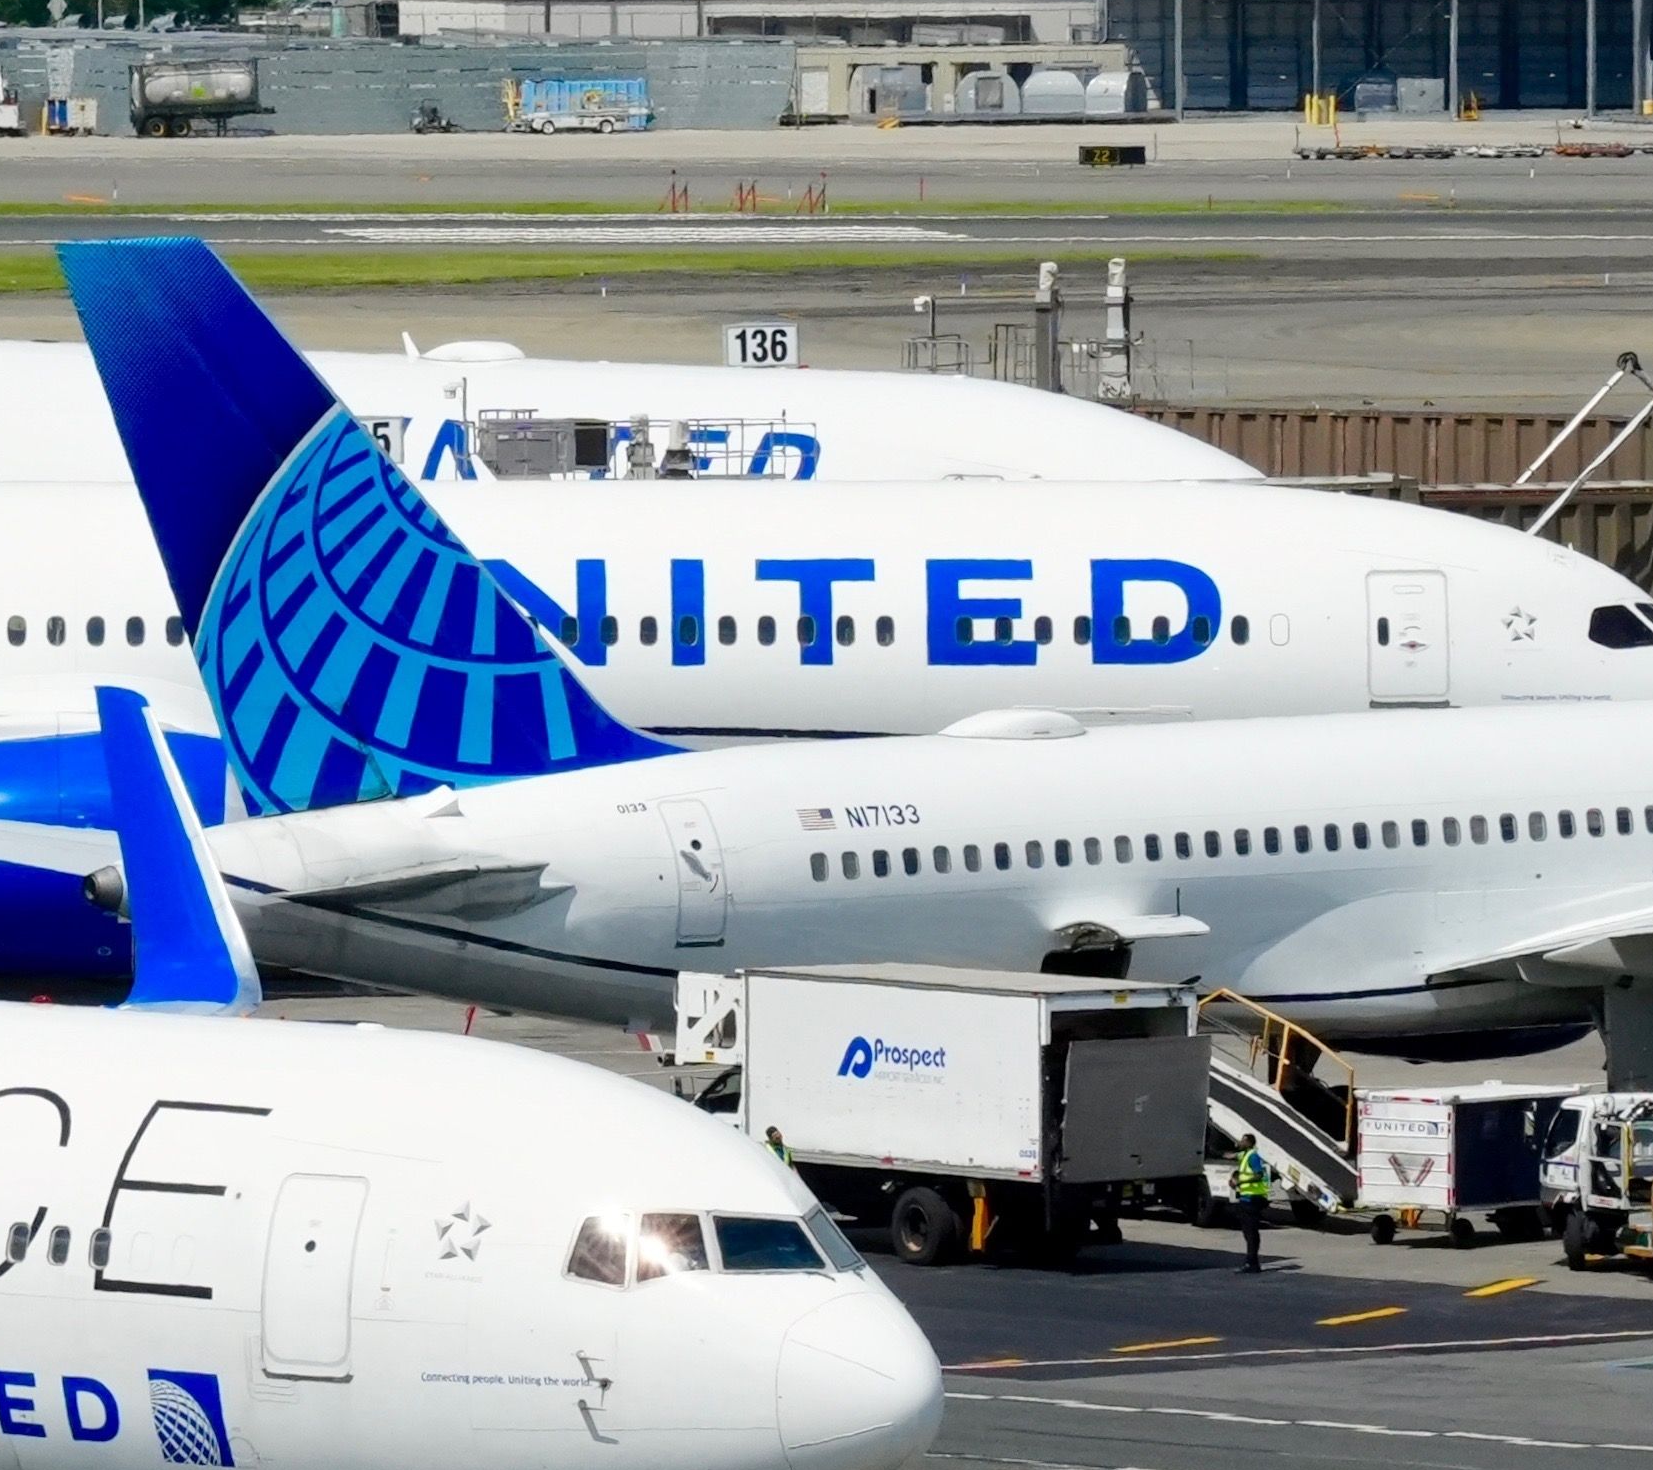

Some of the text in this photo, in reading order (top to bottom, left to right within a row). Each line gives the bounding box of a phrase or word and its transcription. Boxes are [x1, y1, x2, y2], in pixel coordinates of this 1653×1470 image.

[1094, 150, 1108, 162] Z2
[735, 329, 787, 363] 136
[480, 558, 1222, 666] NITED
[617, 803, 647, 815] 0133
[846, 805, 920, 828] N17133
[873, 1038, 946, 1072] Prospect
[1374, 1122, 1425, 1133] UNITED
[421, 1372, 592, 1388] Connecting people. Uniting the world.
